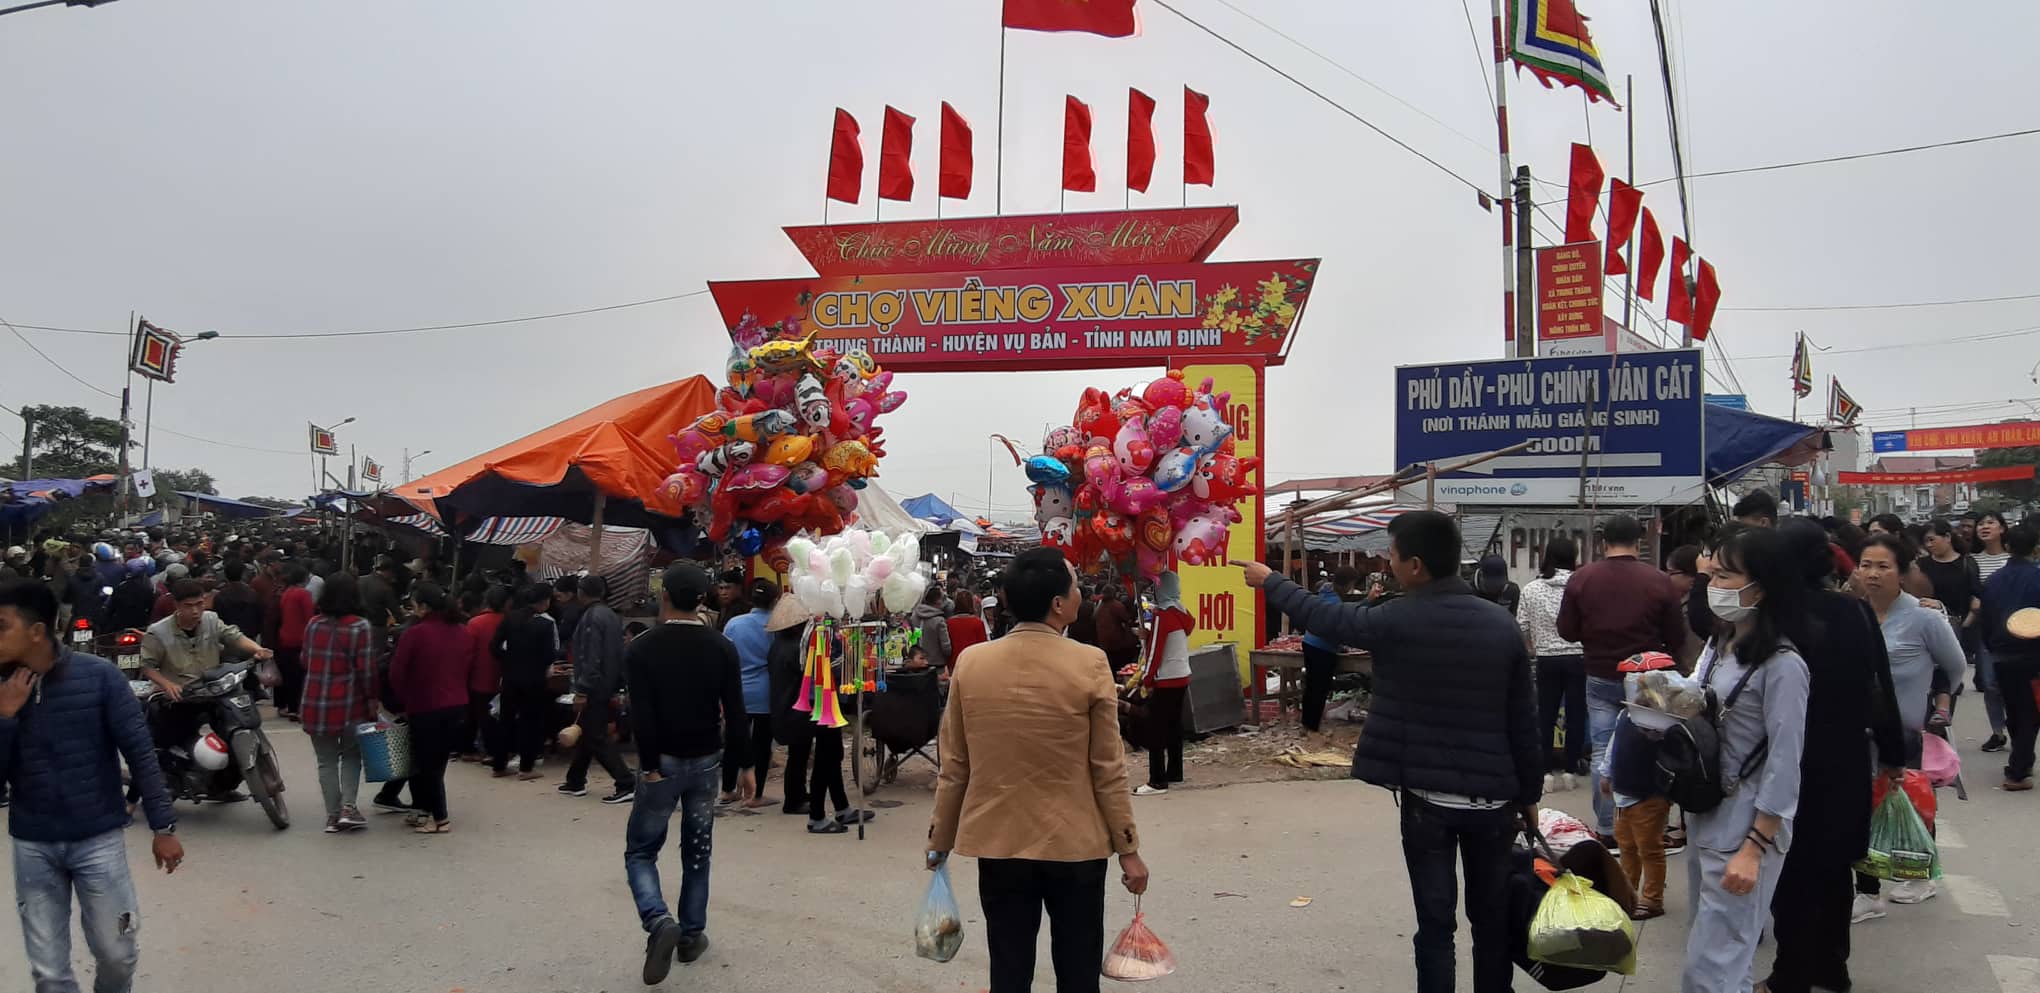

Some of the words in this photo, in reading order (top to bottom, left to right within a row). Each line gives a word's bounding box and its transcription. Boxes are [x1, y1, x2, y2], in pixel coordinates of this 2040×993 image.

[812, 290, 907, 334] CHỢ
[910, 276, 1053, 326] VIỀNG
[1056, 275, 1196, 321] XUÂN
[872, 334, 925, 353] THÀNH
[943, 332, 998, 354] HUYỆN
[1003, 333, 1025, 353] VỤ
[1030, 326, 1066, 349] BẢN
[1084, 326, 1124, 348] TỈNH
[1130, 331, 1171, 347] NAM
[1177, 329, 1222, 350] ĐỊNH
[1408, 367, 1442, 410] PHỦ
[1541, 364, 1600, 405] CHÍNH
[1608, 361, 1648, 402] VÂN
[1655, 359, 1693, 400] CÁT
[1459, 412, 1510, 431] THÁNH
[1516, 408, 1552, 429] MẪU
[1614, 409, 1660, 427] SINH)
[1526, 436, 1600, 453] 500M
[1440, 485, 1506, 496] vinaphone
[1200, 590, 1234, 639] HỢI
